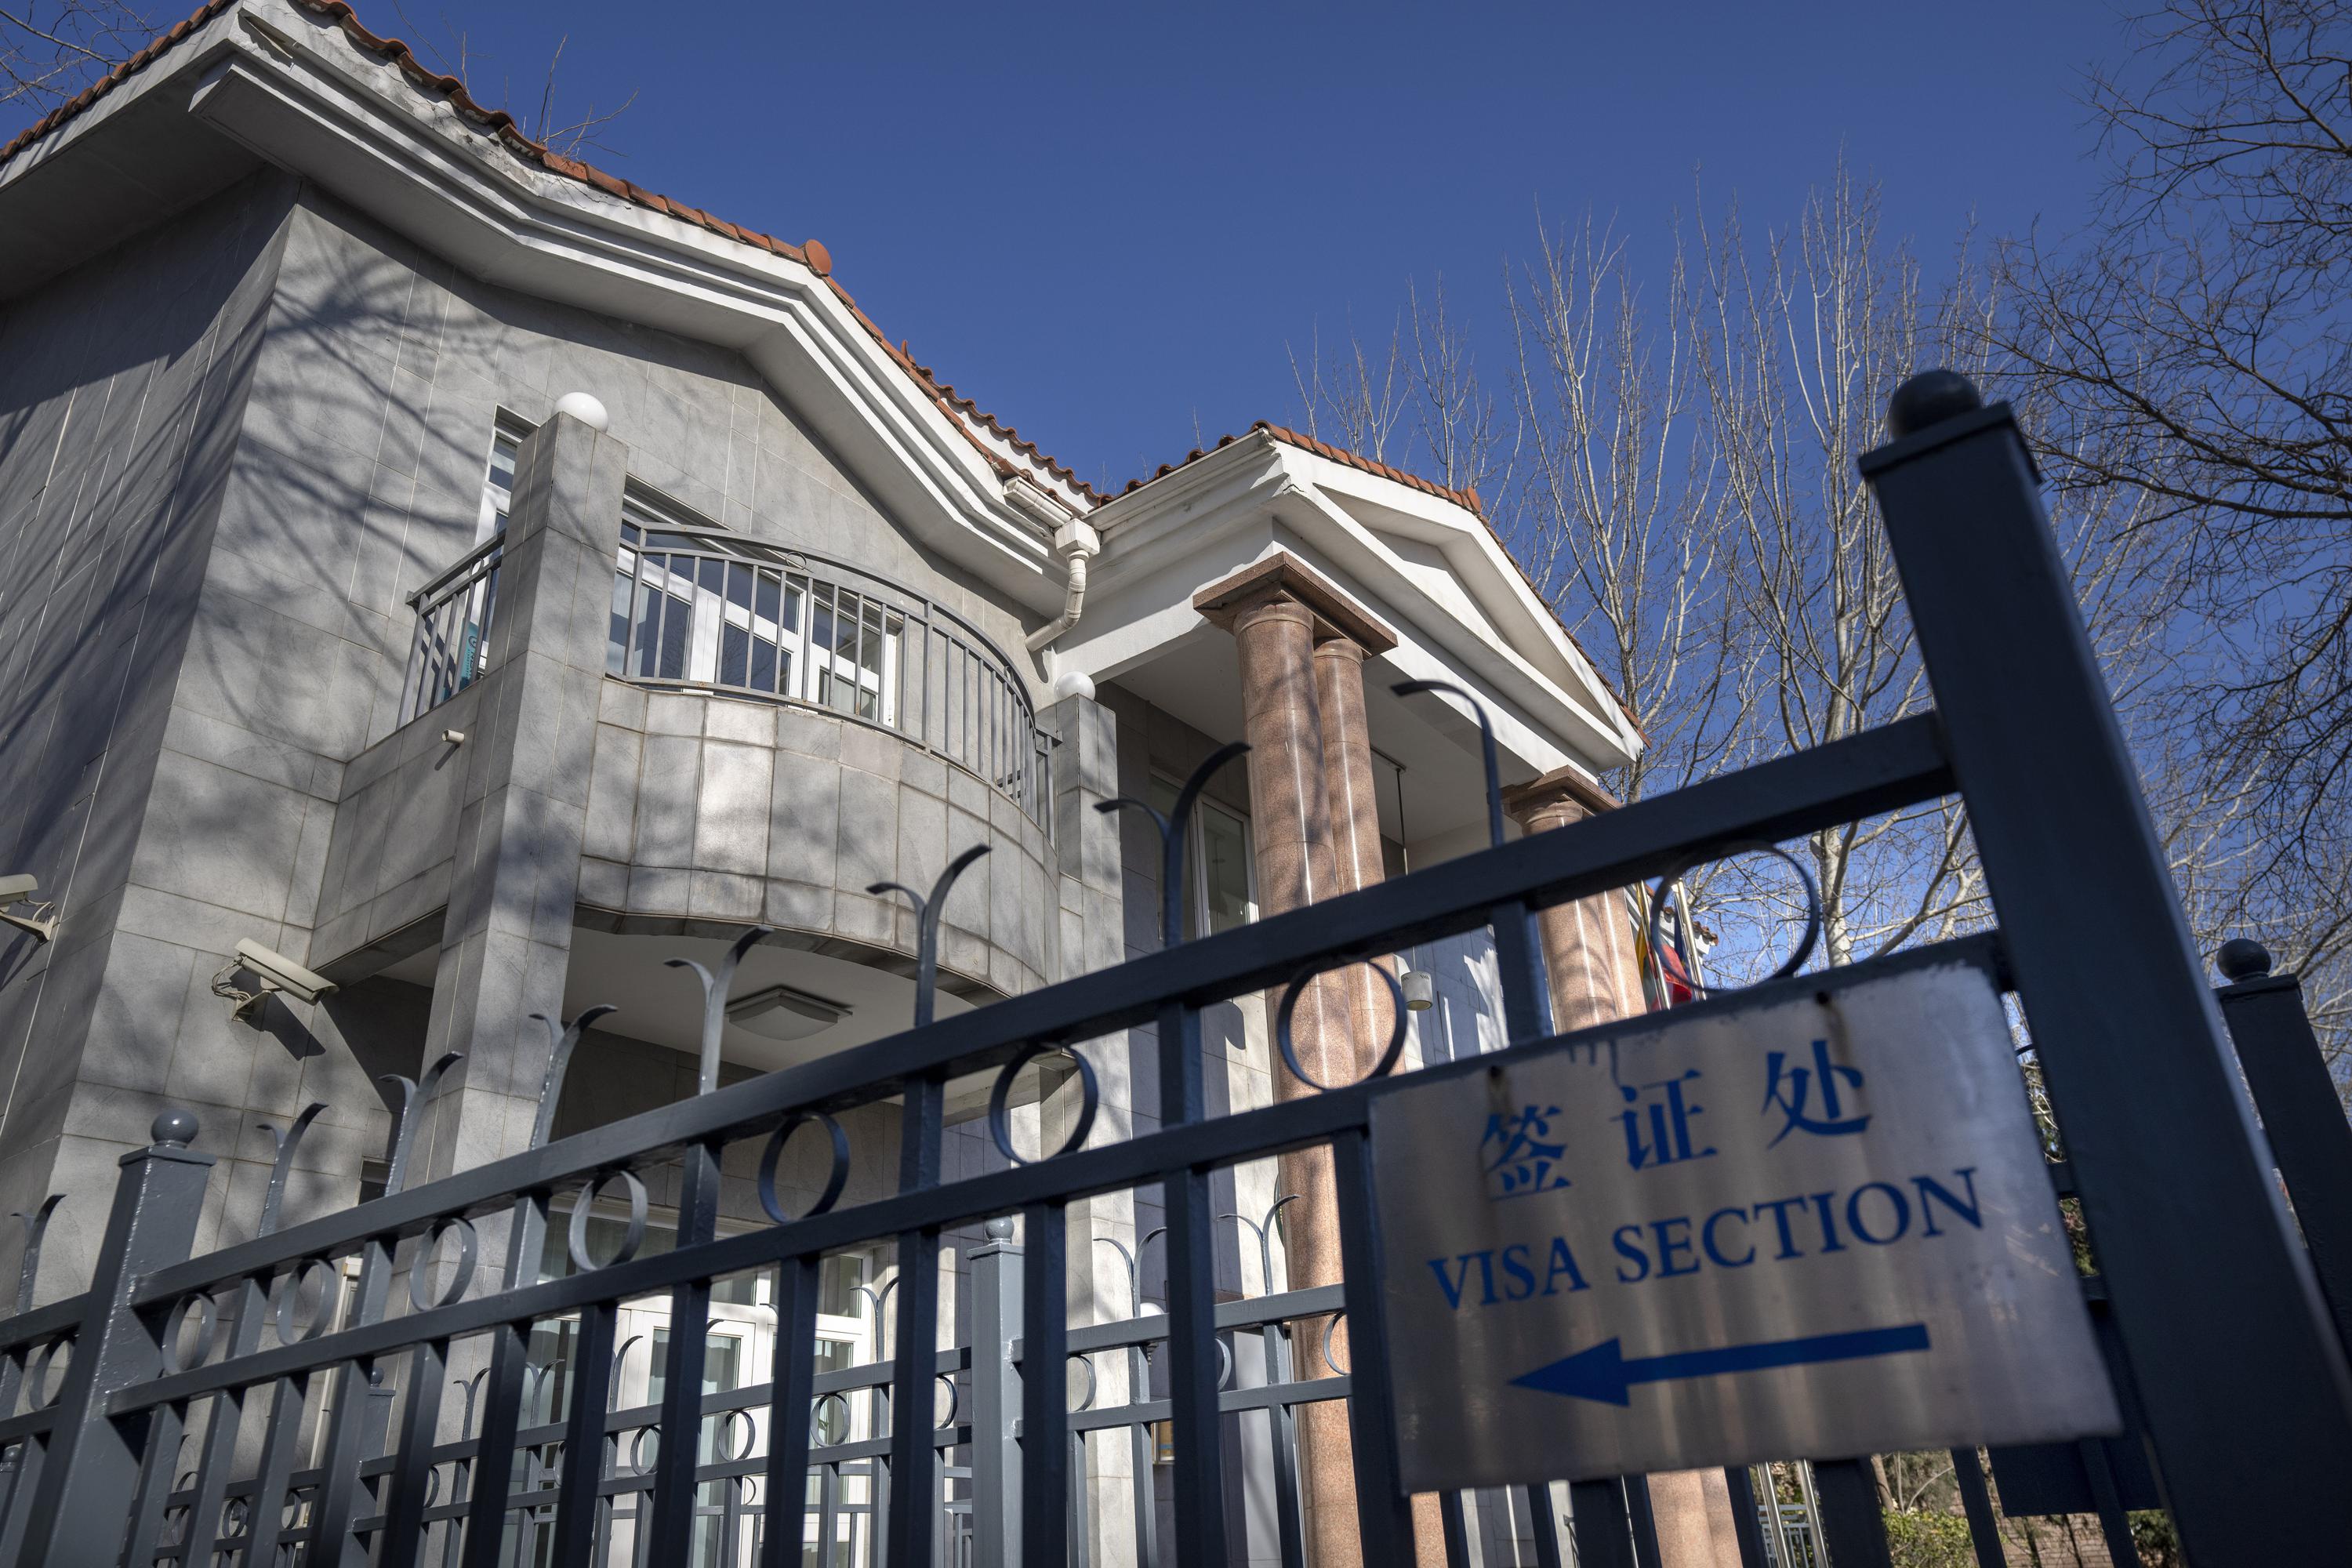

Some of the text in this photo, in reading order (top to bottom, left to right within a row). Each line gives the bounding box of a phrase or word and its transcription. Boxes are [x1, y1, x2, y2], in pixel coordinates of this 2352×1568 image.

[1482, 1039, 1872, 1201] 签证处
[1428, 1167, 1984, 1309] VISA SECTION
